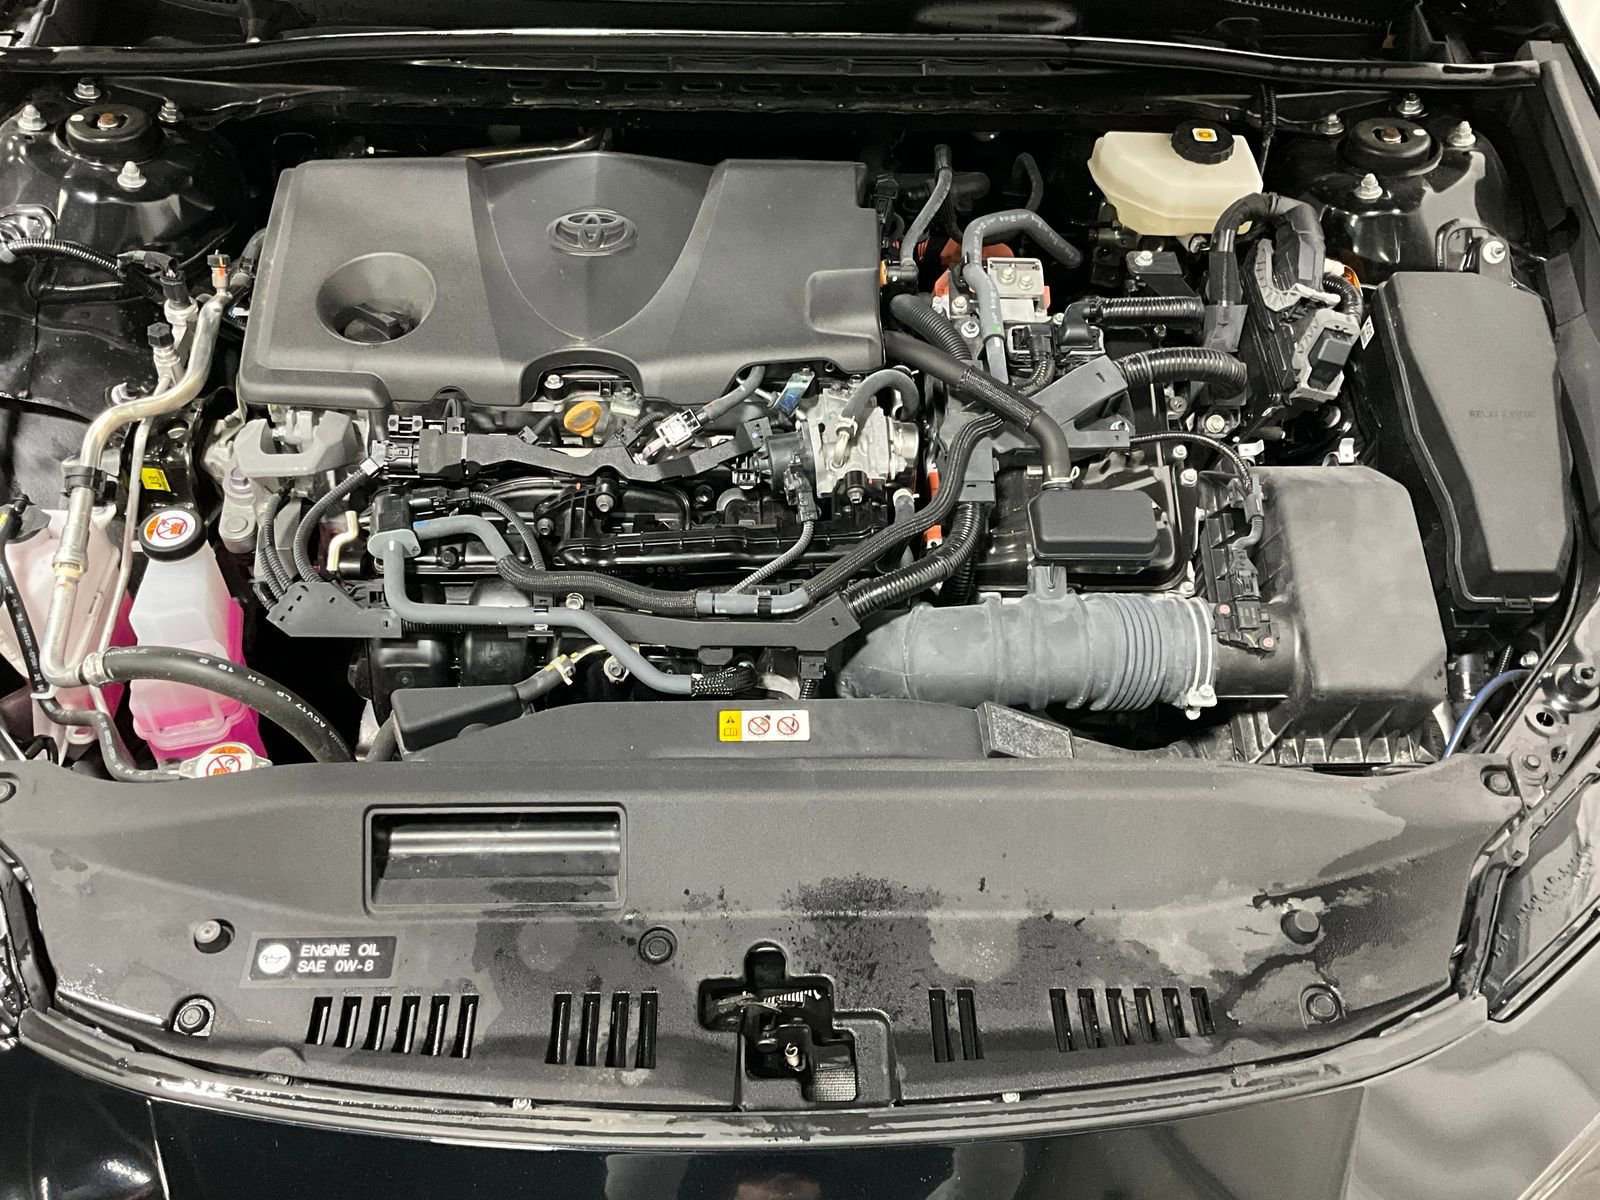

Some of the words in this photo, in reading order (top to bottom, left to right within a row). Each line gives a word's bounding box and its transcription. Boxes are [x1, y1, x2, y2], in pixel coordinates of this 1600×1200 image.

[276, 690, 292, 702] LP
[295, 703, 326, 728] ACV17
[300, 944, 351, 956] ENGINE
[357, 943, 380, 956] OIL
[297, 959, 327, 973] SAE
[334, 959, 374, 972] 0W-8
